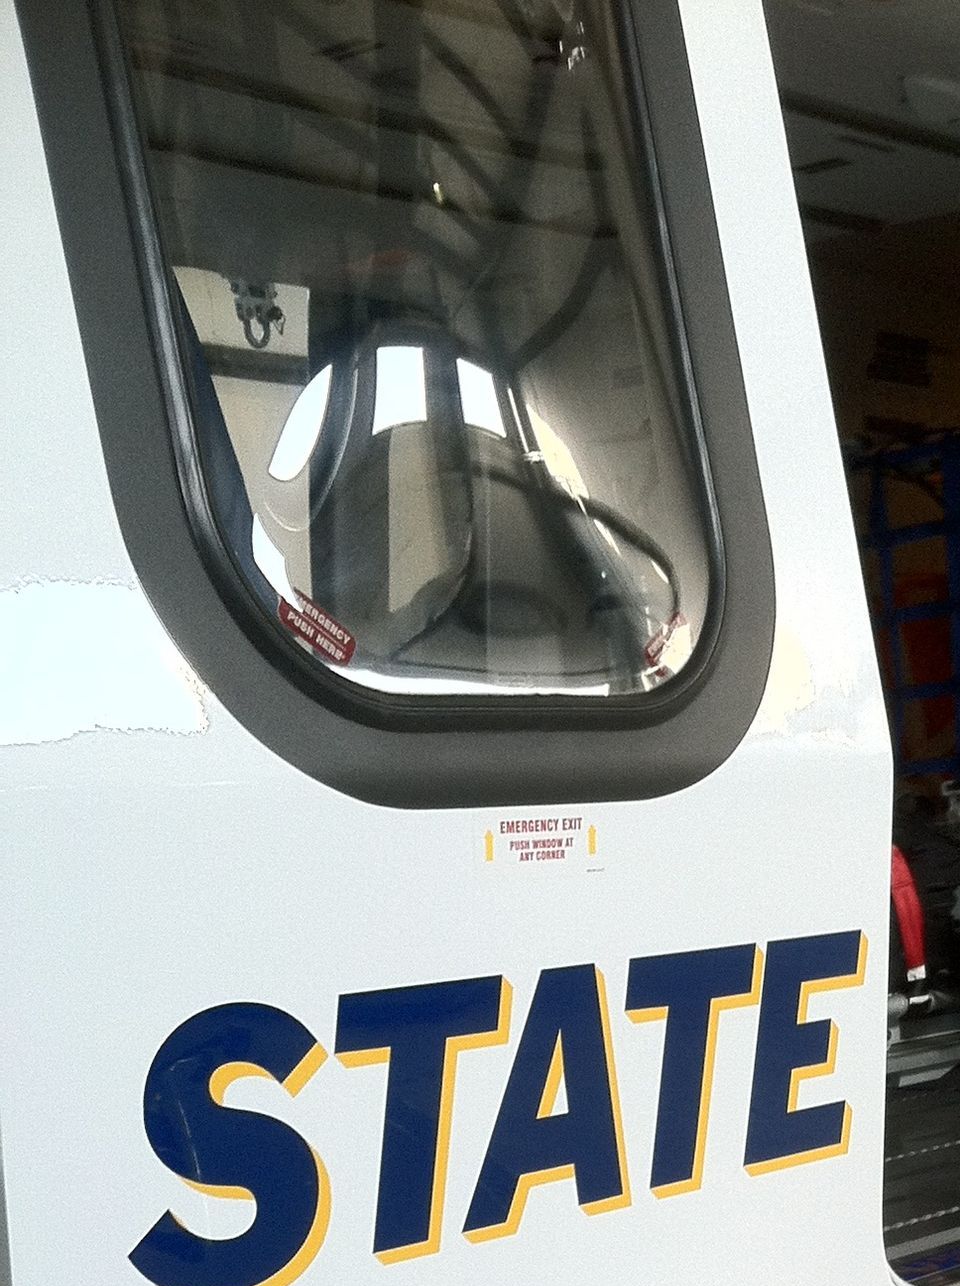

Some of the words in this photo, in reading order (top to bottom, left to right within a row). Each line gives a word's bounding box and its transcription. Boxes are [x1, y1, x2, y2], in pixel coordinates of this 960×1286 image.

[294, 594, 351, 645] MERGENCY
[287, 611, 315, 638] PUSH
[316, 633, 345, 660] HERE
[500, 819, 559, 834] EMERGENCY
[562, 818, 582, 830] EXIT
[510, 840, 530, 851] PUSH
[532, 838, 563, 849] WINDOW
[565, 837, 574, 847] AT
[519, 852, 534, 861] ANY
[536, 850, 565, 860] CORNER
